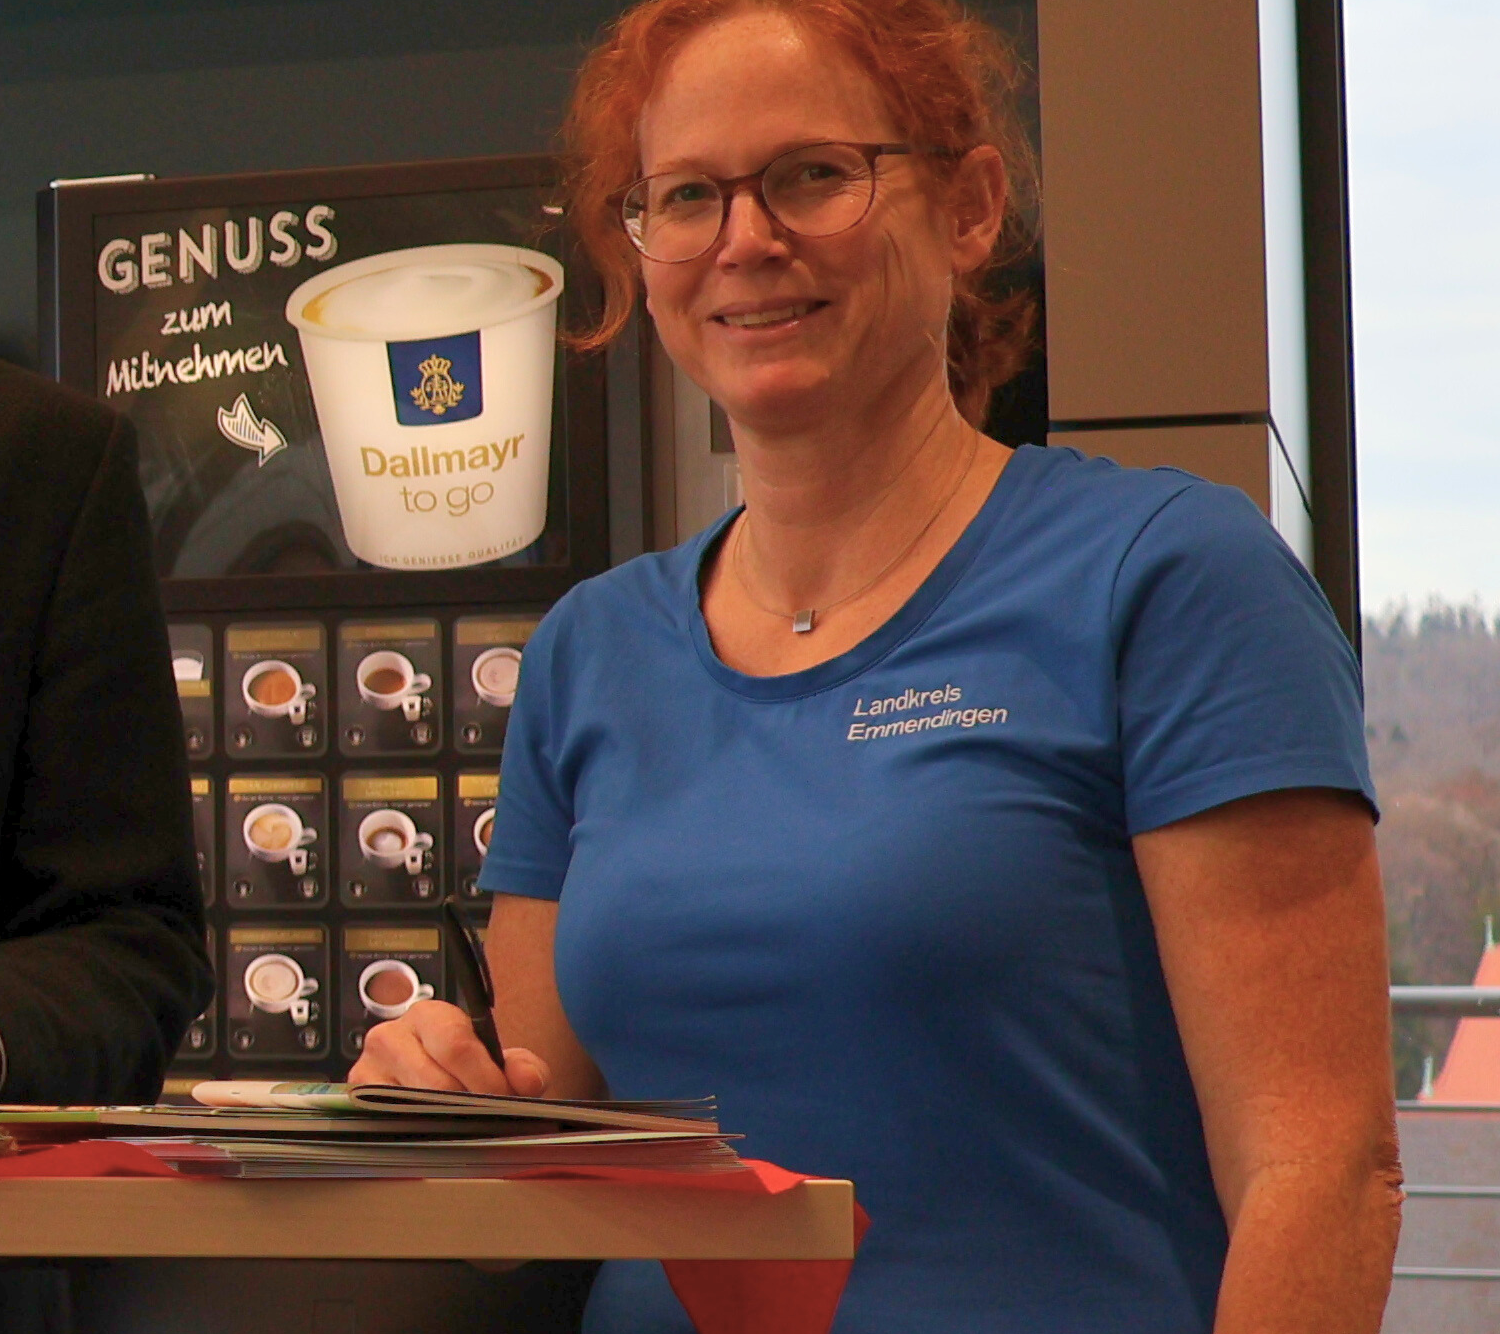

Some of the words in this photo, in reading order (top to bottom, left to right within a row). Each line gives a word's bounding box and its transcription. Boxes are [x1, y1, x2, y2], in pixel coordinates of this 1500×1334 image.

[98, 205, 338, 295] GENUSS
[161, 301, 231, 336] zum
[106, 341, 288, 397] Mitnehmen
[360, 433, 525, 477] Dallmayr
[399, 486, 437, 513] to
[446, 482, 494, 517] go
[853, 683, 962, 718] Landkreis
[847, 706, 1008, 741] Emmendingen
